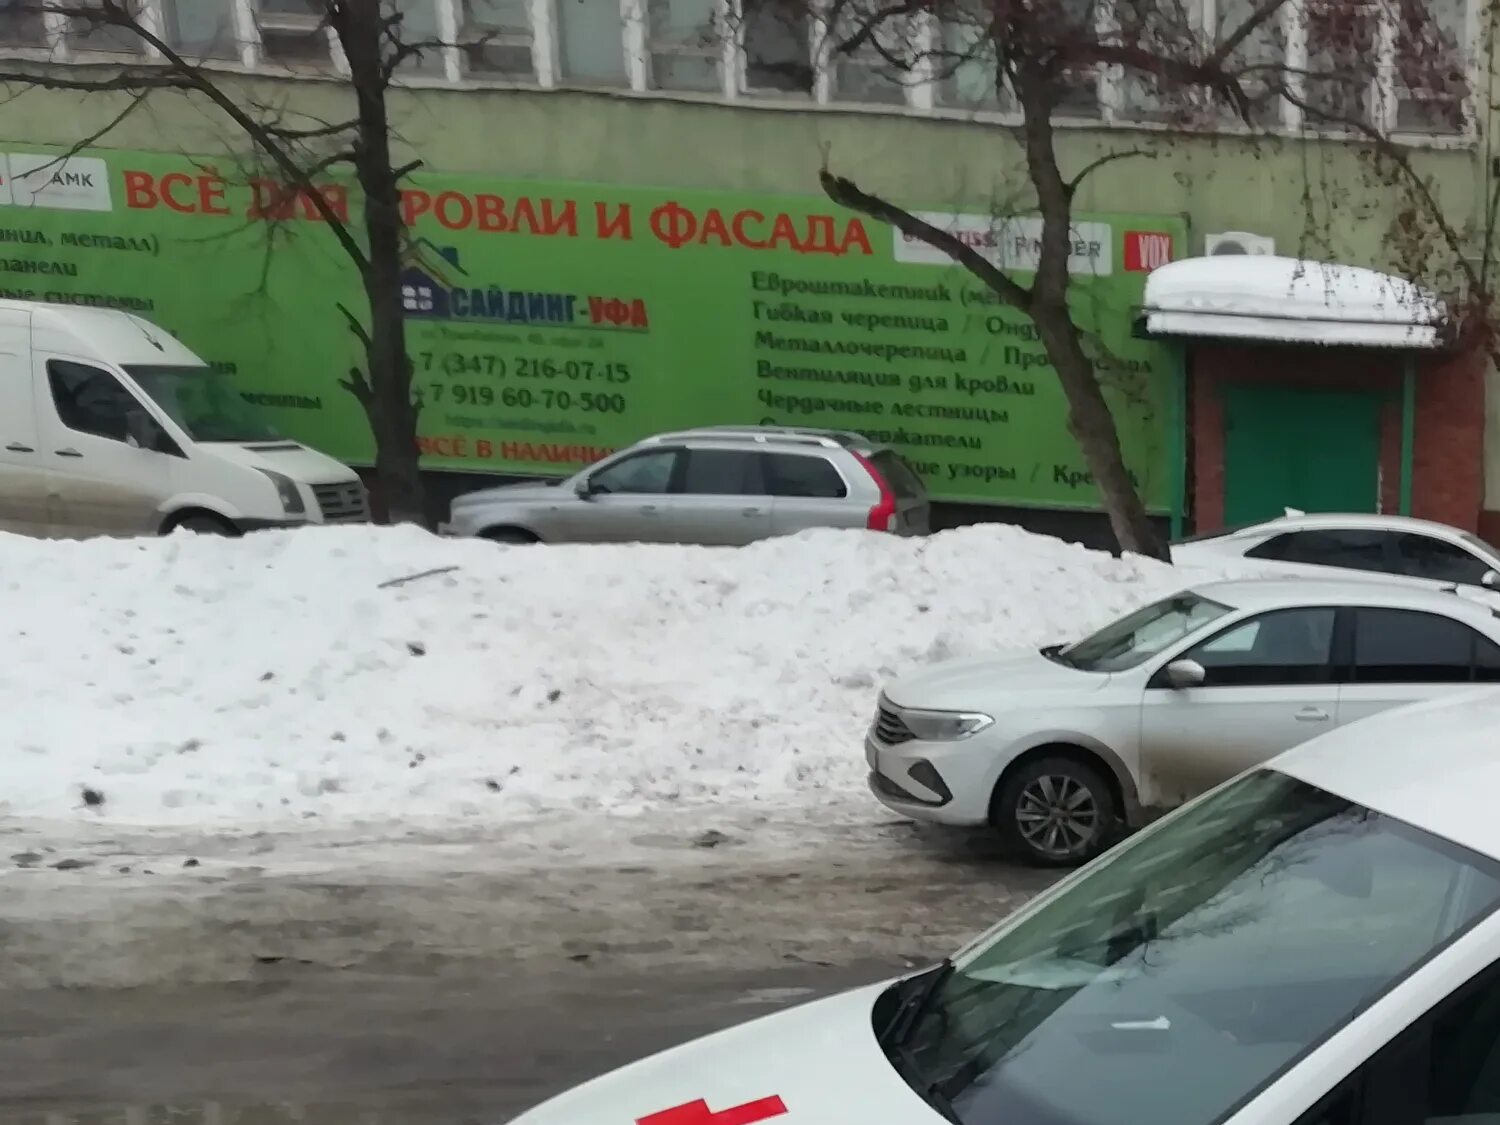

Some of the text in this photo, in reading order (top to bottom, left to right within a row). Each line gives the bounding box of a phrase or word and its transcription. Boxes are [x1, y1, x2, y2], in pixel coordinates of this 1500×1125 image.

[123, 166, 231, 216] ВСЁ
[397, 189, 578, 237] РОВЛИ
[595, 202, 633, 241] И
[650, 201, 873, 257] ФАСАДА
[753, 301, 833, 324] Гибкая
[841, 311, 949, 332] черепица
[755, 330, 967, 363] Металлочерепица
[515, 358, 631, 383] 216-07-15
[757, 359, 1035, 396] Вентиляция для кровли
[502, 387, 625, 413] 60-70-500
[757, 388, 1009, 424] Чердачные лестницы
[477, 440, 493, 459] В
[502, 441, 614, 464] НАЛИЧИ
[948, 463, 1016, 483] узоры
